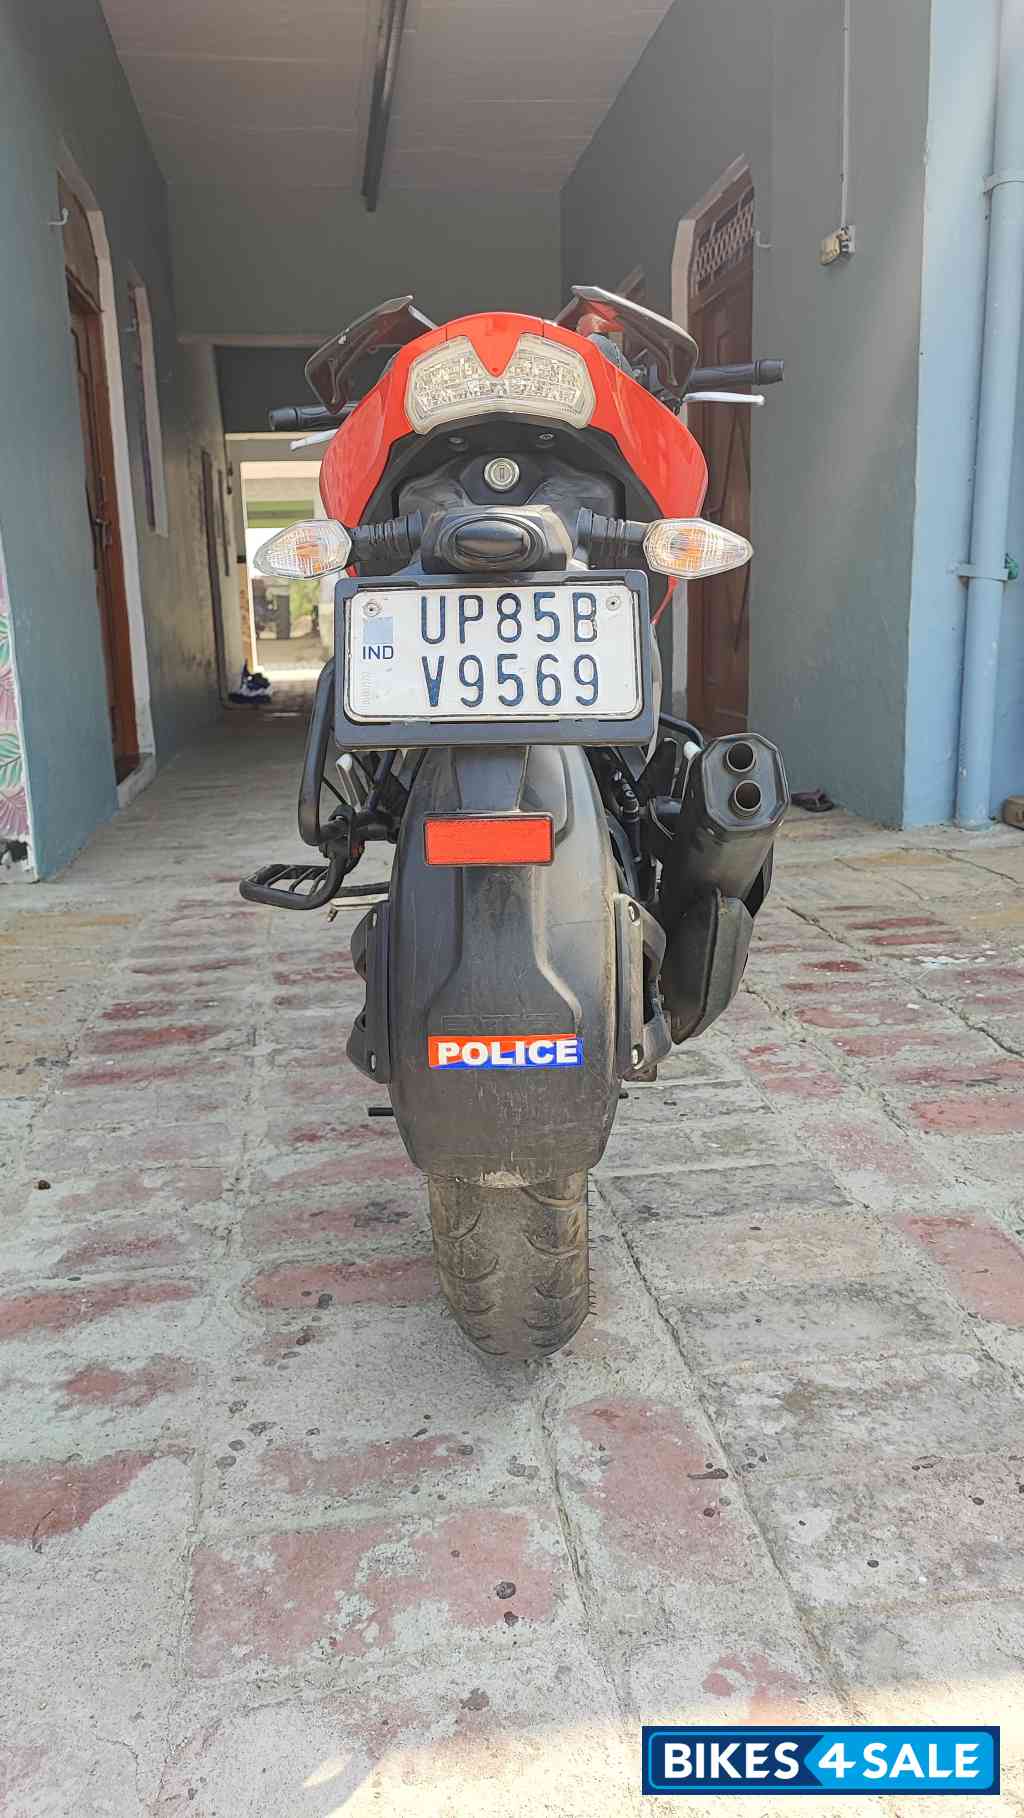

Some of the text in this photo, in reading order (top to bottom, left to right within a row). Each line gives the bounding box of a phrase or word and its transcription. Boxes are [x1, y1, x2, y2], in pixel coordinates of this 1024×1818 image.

[420, 591, 598, 644] UP85B
[362, 645, 394, 660] IND
[421, 653, 599, 707] V9569
[437, 1039, 578, 1066] POLICE
